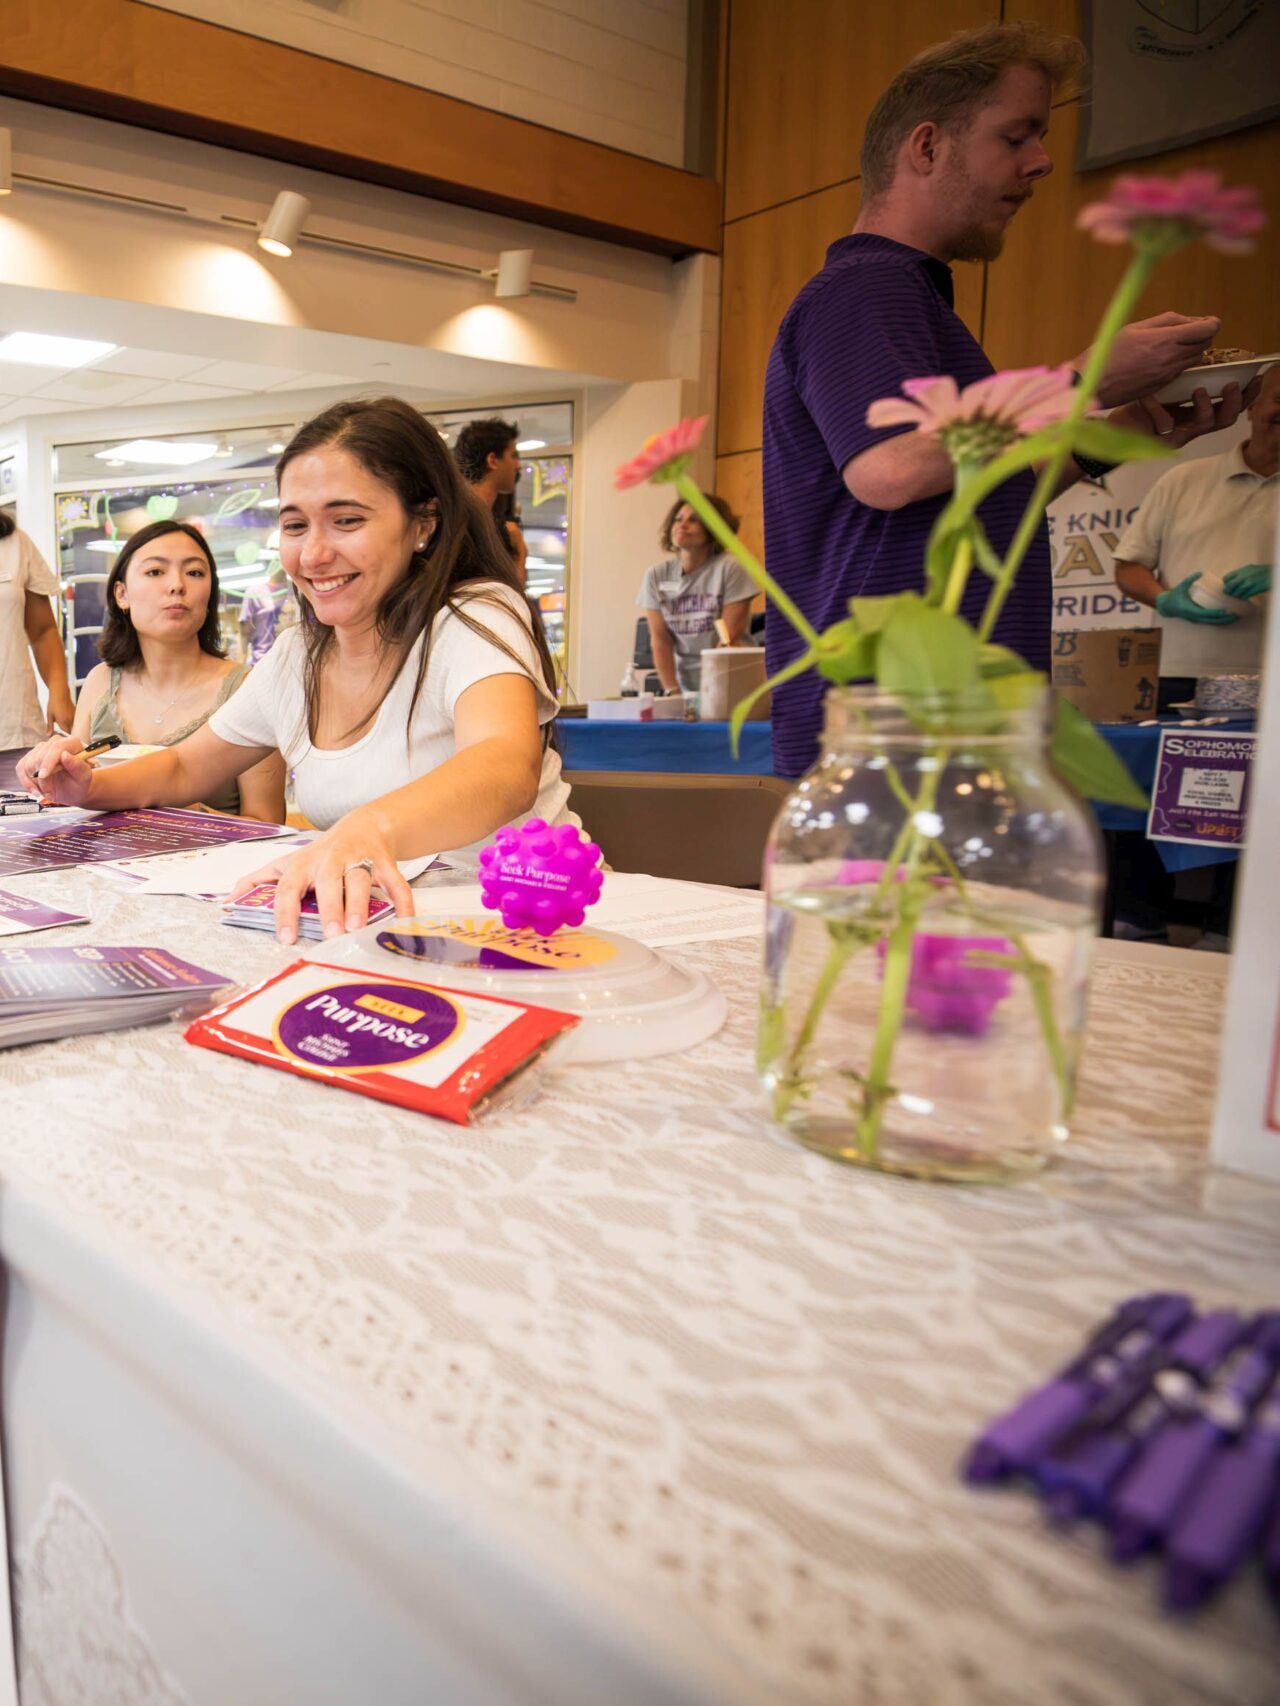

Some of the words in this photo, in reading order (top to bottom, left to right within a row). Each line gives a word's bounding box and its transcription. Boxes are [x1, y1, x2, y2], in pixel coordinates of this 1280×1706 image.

[1055, 594, 1141, 617] RIDE
[500, 861, 524, 875] Seek
[525, 866, 572, 885] Purpose
[305, 994, 430, 1049] Purpose
